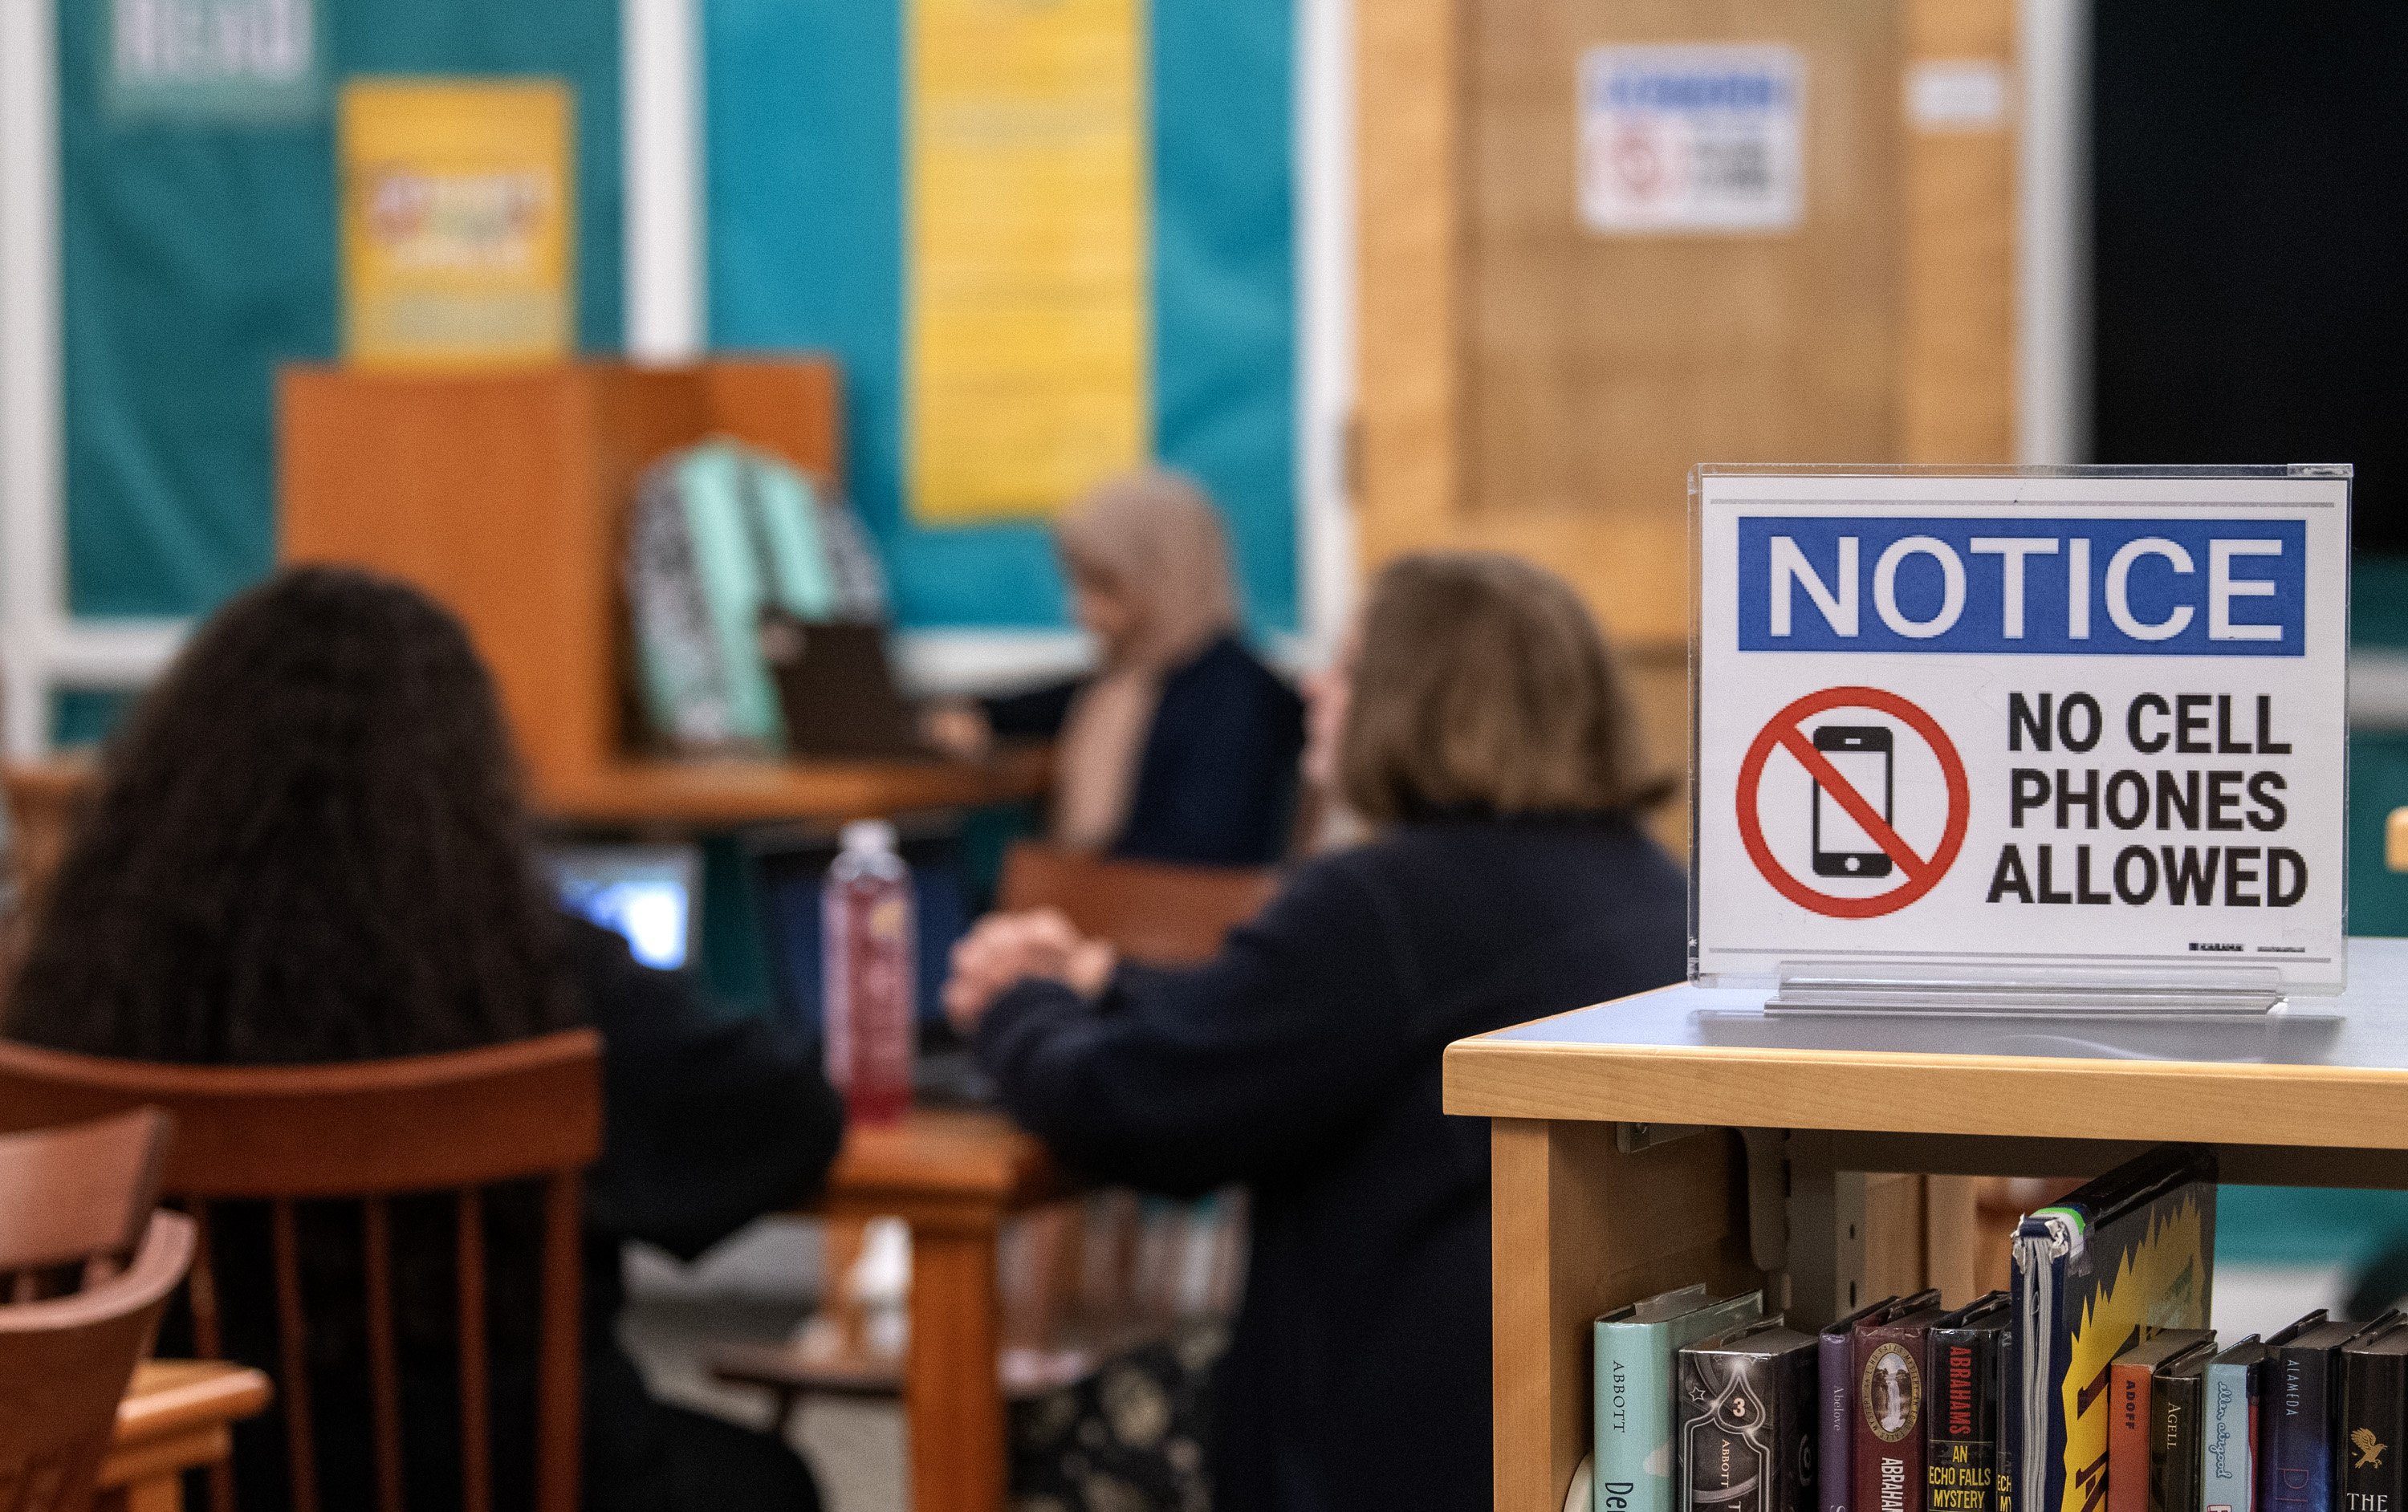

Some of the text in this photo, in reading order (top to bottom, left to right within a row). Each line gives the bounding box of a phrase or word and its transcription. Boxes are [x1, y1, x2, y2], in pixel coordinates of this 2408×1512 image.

[1768, 534, 2284, 641] NOTICE
[2008, 691, 2293, 755] NO CELL
[2009, 768, 2288, 832] PHONES
[1985, 844, 2308, 908] ALLOWED
[1613, 1360, 1625, 1433] ABBOTT
[1732, 1397, 1746, 1418] 3
[1833, 1385, 1845, 1431] Abelove
[1950, 1346, 1971, 1435] ABRAHAMS
[2125, 1380, 2136, 1430] ADOFF
[2285, 1359, 2300, 1416] ALAMEDA
[2167, 1402, 2182, 1450] AGELL
[2208, 1381, 2233, 1478] ellen airgood
[1720, 1438, 1731, 1489] ABBOTT
[1929, 1465, 1991, 1486] ECHO FALLS
[1952, 1445, 1968, 1463] AN
[1605, 1482, 1634, 1512] De
[1934, 1489, 1985, 1509] MYSTERY
[2347, 1493, 2388, 1512] THE
